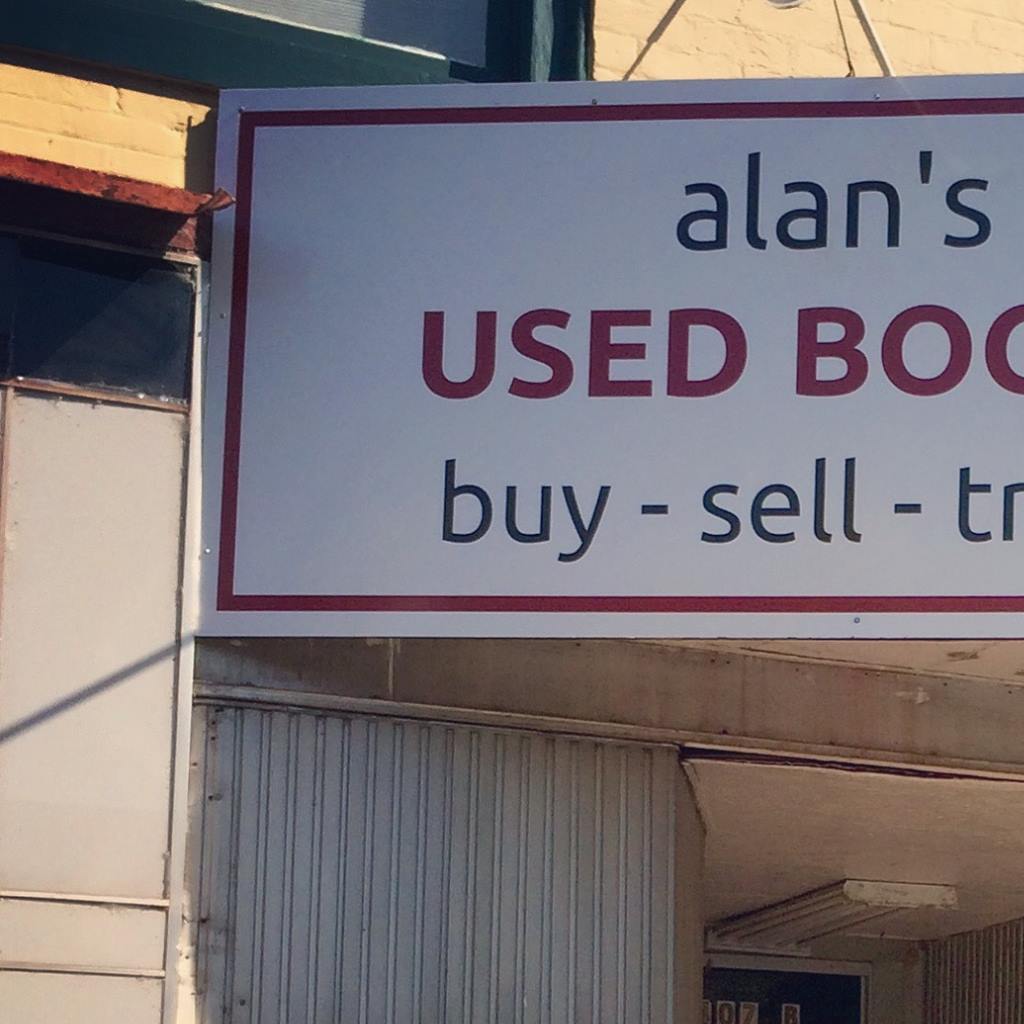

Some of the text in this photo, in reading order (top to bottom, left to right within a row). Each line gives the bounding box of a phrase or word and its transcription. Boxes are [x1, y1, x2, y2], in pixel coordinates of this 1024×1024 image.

[675, 150, 993, 252] alan's
[421, 307, 748, 399] USED
[441, 458, 612, 563] buy
[700, 457, 863, 545] sell
